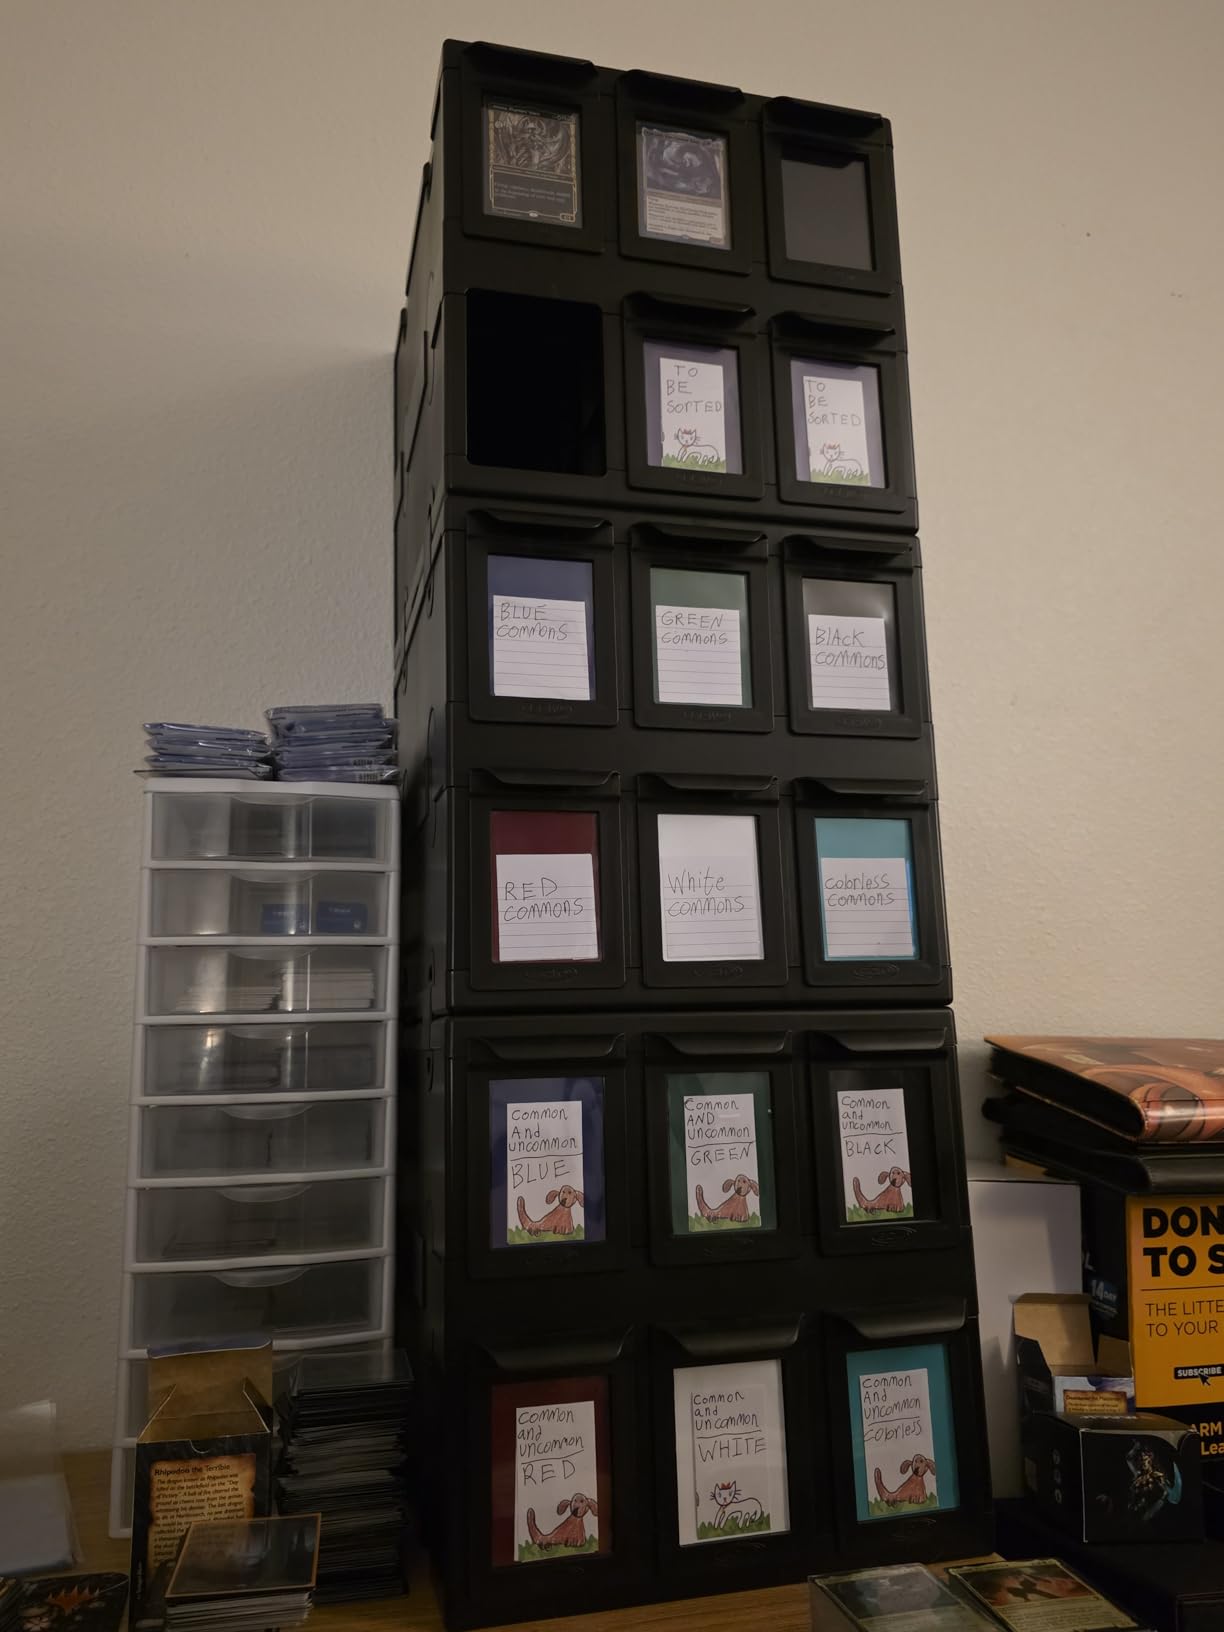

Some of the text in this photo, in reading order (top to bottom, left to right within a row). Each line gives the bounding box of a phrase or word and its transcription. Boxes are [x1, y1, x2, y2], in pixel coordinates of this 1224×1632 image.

[673, 364, 698, 378] TO
[666, 378, 693, 396] BE
[807, 380, 826, 392] TO
[808, 395, 829, 408] BE
[807, 412, 862, 427] SORTED
[500, 602, 548, 621] BLUE
[661, 610, 725, 630] GREEN
[504, 876, 558, 901] RED
[667, 866, 726, 896] White
[684, 1097, 741, 1111] Common
[511, 1107, 569, 1121] Common
[686, 1111, 715, 1126] AND
[511, 1122, 542, 1140] And
[690, 1142, 754, 1166] GREEN
[845, 1138, 897, 1158] BLACK
[511, 1159, 571, 1189] BLUE
[1143, 1245, 1197, 1277] TO
[1145, 1302, 1177, 1316] THE
[1146, 1320, 1218, 1337] TO YOUR
[1177, 1366, 1222, 1377] SUBSCRIBE
[861, 1375, 913, 1389] Common
[693, 1391, 745, 1406] Common
[698, 1437, 767, 1463] WHITE
[522, 1459, 577, 1486] RED
